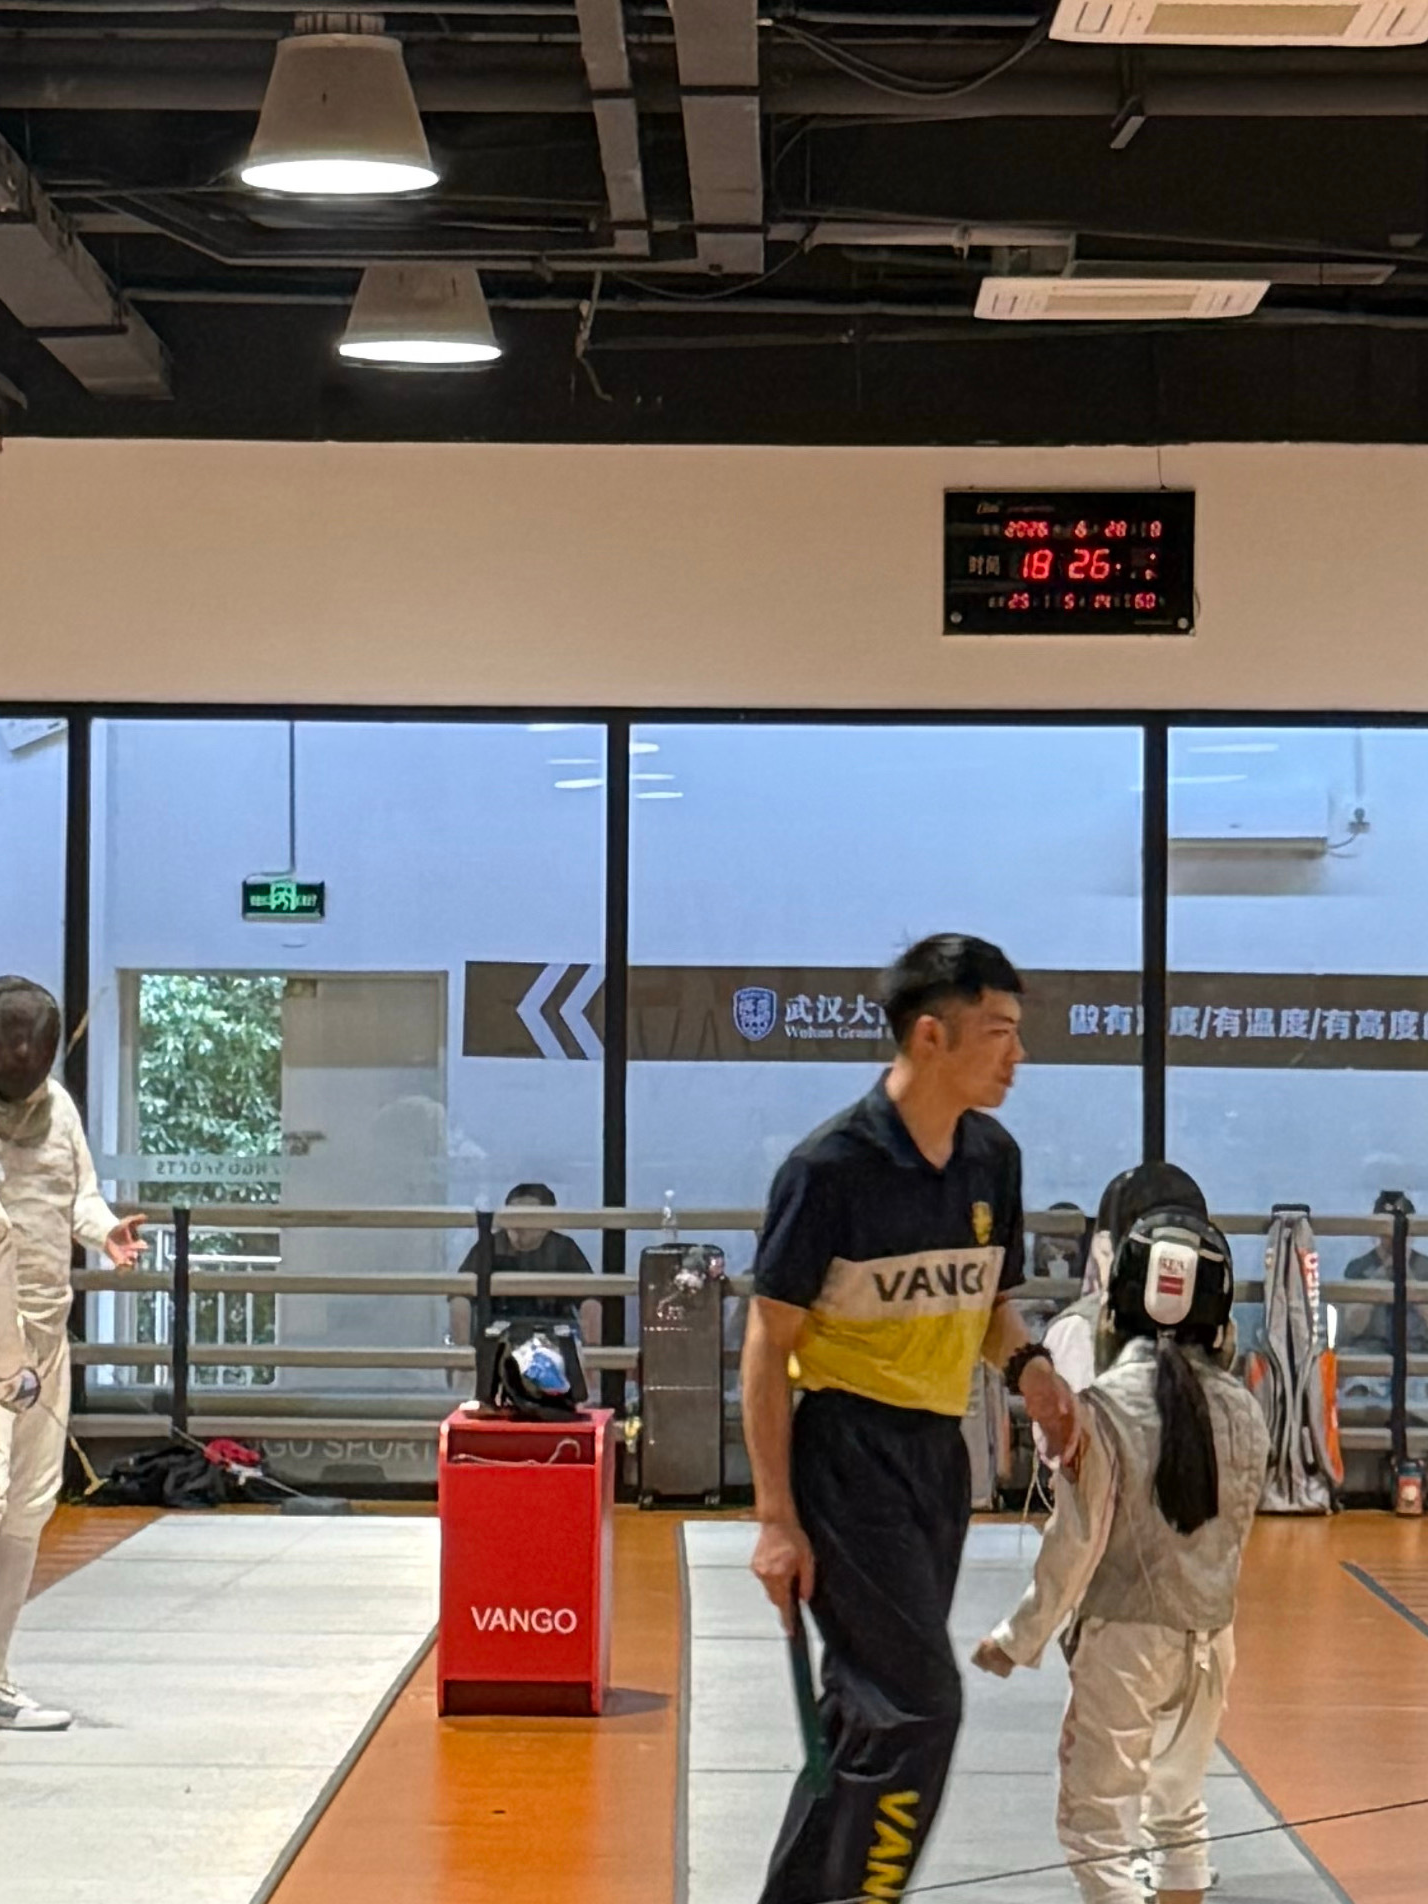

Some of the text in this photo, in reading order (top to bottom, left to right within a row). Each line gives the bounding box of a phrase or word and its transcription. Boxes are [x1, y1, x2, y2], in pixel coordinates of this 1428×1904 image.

[784, 993, 888, 1025] 武汉大
[470, 1606, 578, 1635] VANGO
